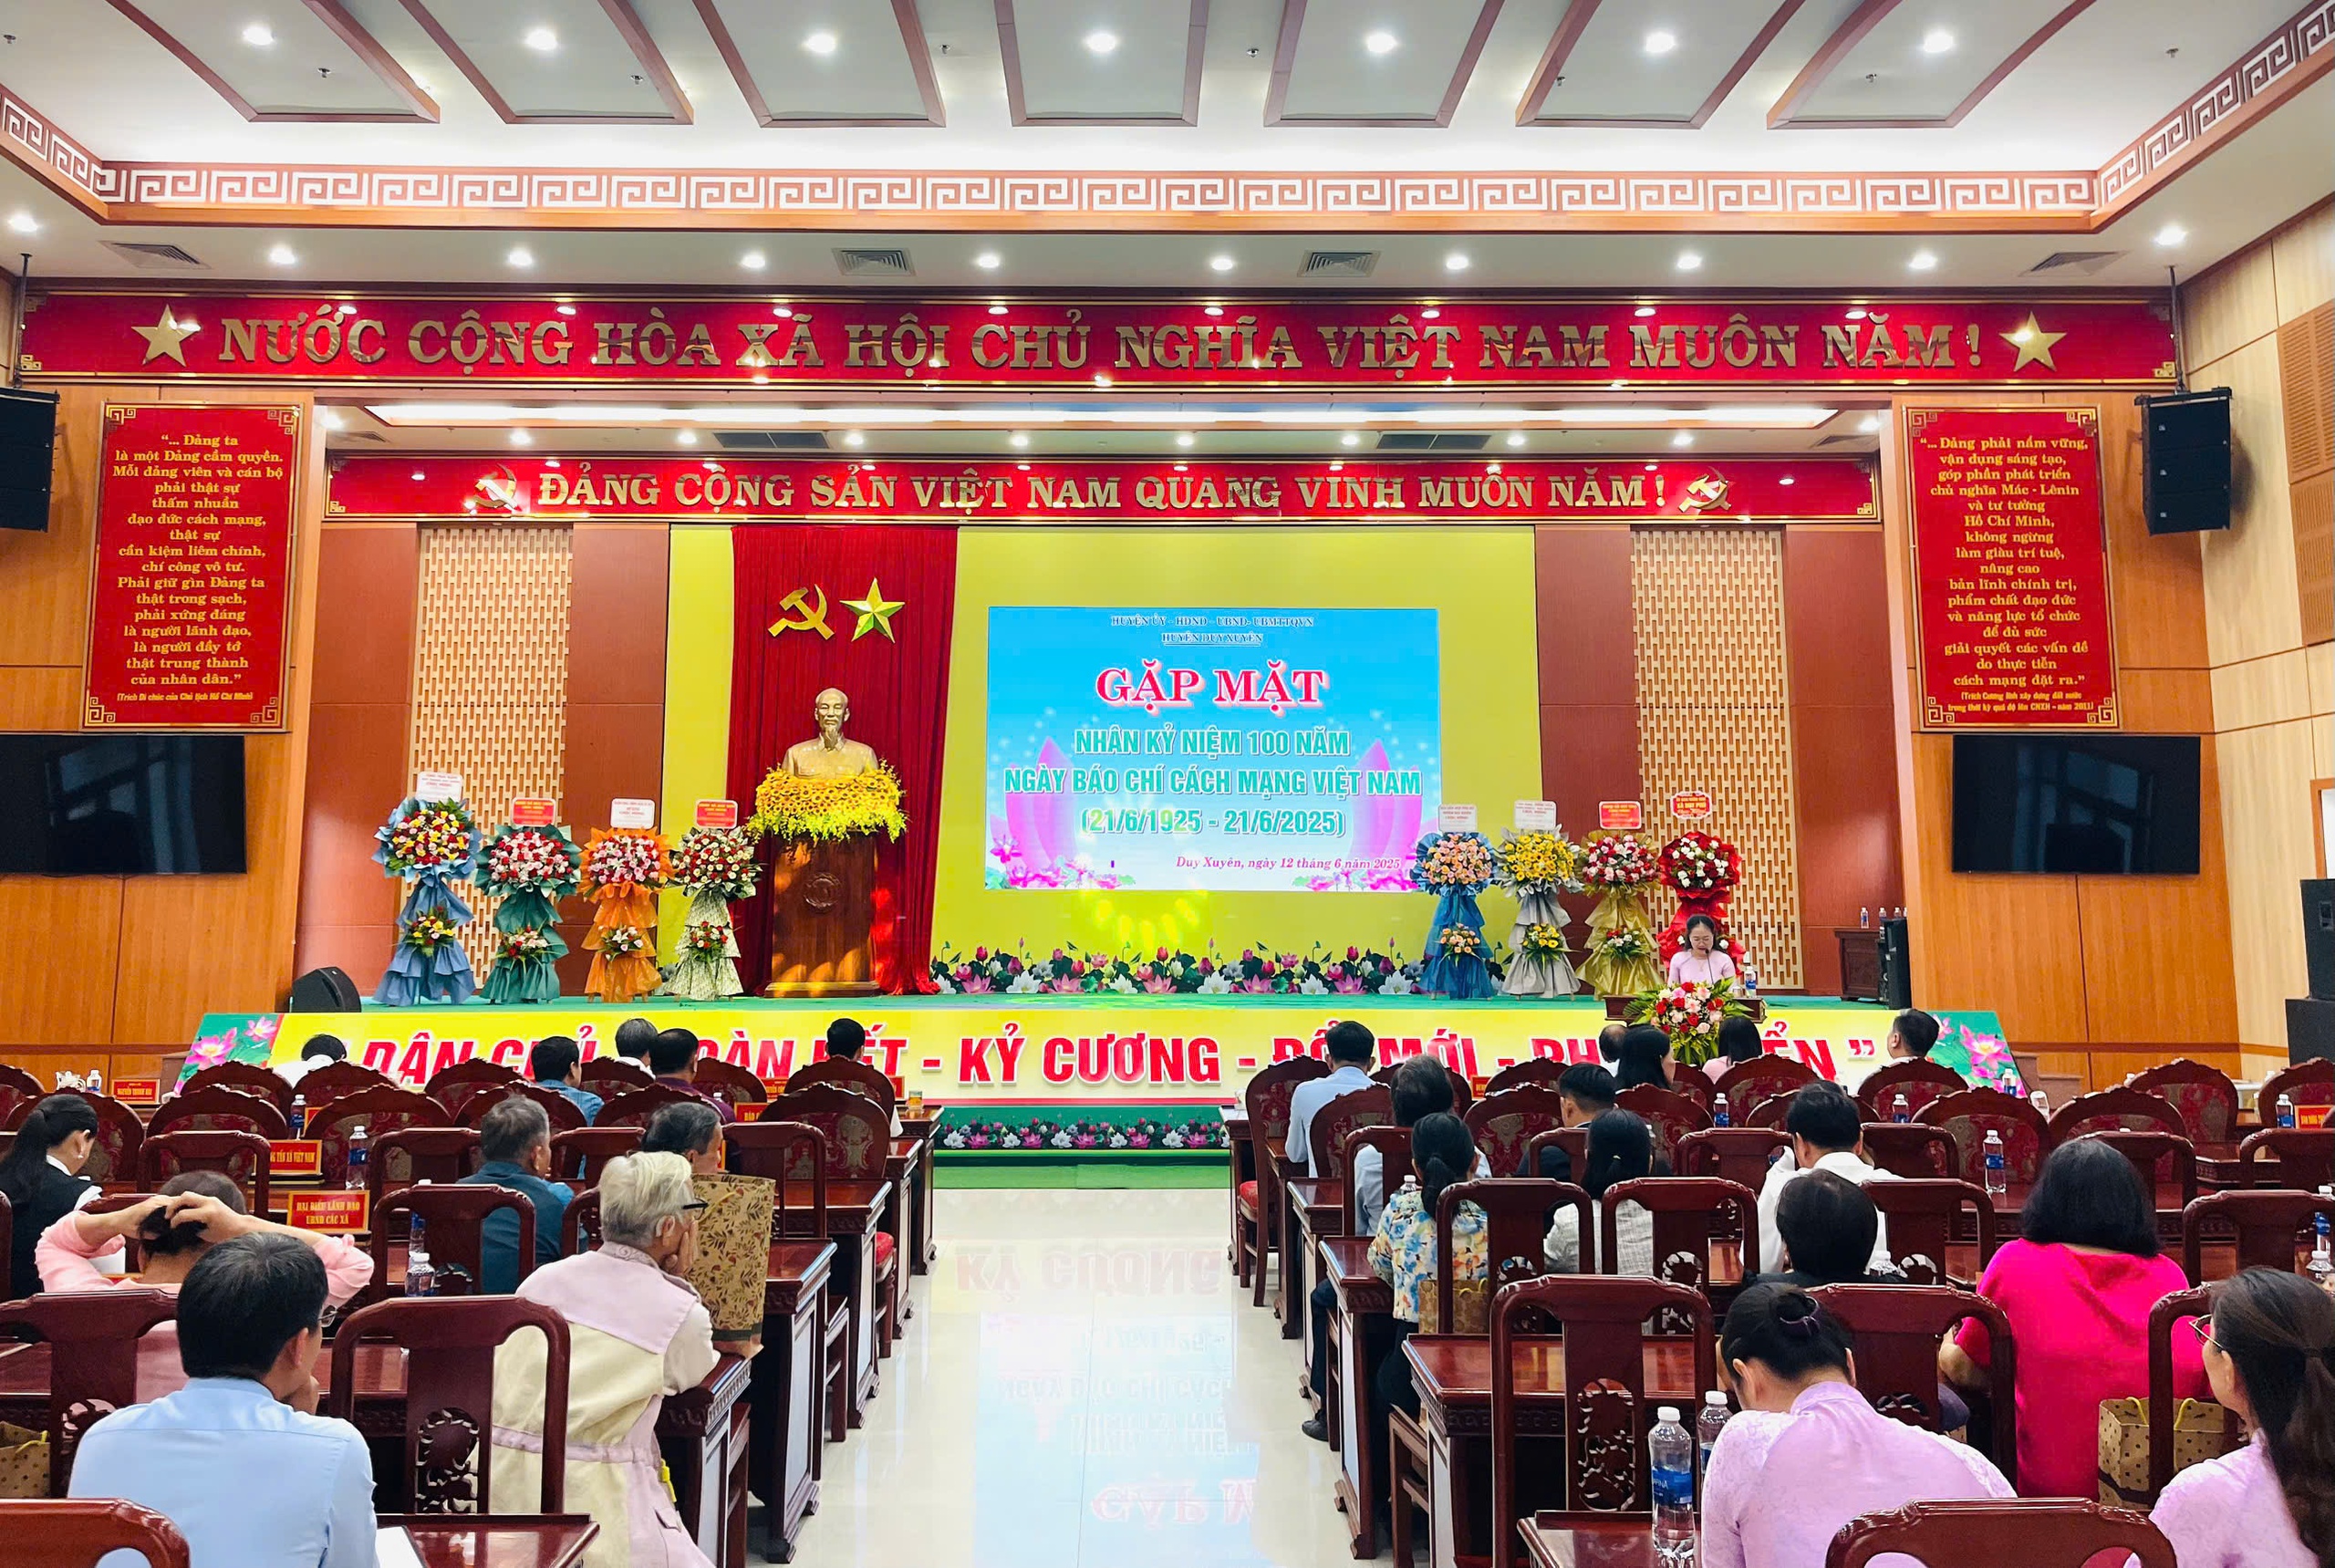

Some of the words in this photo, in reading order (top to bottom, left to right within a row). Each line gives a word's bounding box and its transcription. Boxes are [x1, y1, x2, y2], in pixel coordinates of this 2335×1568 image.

[218, 304, 386, 363] NƯỚC
[408, 309, 574, 375] CỘNG
[593, 306, 721, 366] HÒA
[736, 313, 825, 367] XÃ
[844, 312, 950, 377] HỘI
[970, 308, 1091, 368] CHỦ
[1116, 316, 1303, 369] NGHĨA
[1316, 313, 1461, 379] VIỆT
[1478, 325, 1611, 369] NAM
[1629, 313, 1800, 369] MUÔN
[537, 462, 660, 506] ĐẢNG
[675, 466, 795, 514] CỘNG
[810, 464, 898, 507] SẢN
[910, 467, 1013, 514] VIỆT
[1027, 476, 1121, 509] NAM
[1135, 476, 1282, 510] QUANG
[1294, 476, 1406, 509] VINH
[1417, 464, 1535, 509] MUÔN
[1095, 659, 1204, 714] GẶP
[1213, 659, 1328, 714] MẶT
[1074, 726, 1140, 755] NHÂN
[1147, 722, 1179, 755] KỶ
[1181, 728, 1242, 760] NIỆM
[1248, 731, 1291, 756] 100
[1295, 727, 1351, 756] NĂM
[1004, 763, 1066, 794] NGÀY
[1072, 763, 1119, 794] BÁO
[1125, 763, 1165, 794] CHÍ
[1169, 764, 1231, 795] CÁCH
[1238, 770, 1306, 800] MẠNG
[1312, 764, 1362, 801] VIỆT
[1367, 771, 1423, 796] NAM
[1080, 807, 1203, 835] (21/6/1925
[1223, 809, 1346, 837] 21/6/2025)
[1176, 857, 1200, 869] Duy
[1203, 856, 1245, 869] Xuyên,
[1248, 857, 1277, 869] ngày
[1280, 857, 1293, 868] 12
[1296, 857, 1332, 869] tháng
[1334, 858, 1341, 868] 6
[1344, 858, 1371, 869] năm
[1373, 858, 1401, 869] 2025
[958, 1023, 1025, 1083] KỶ
[1043, 1032, 1221, 1084] CƯƠNG
